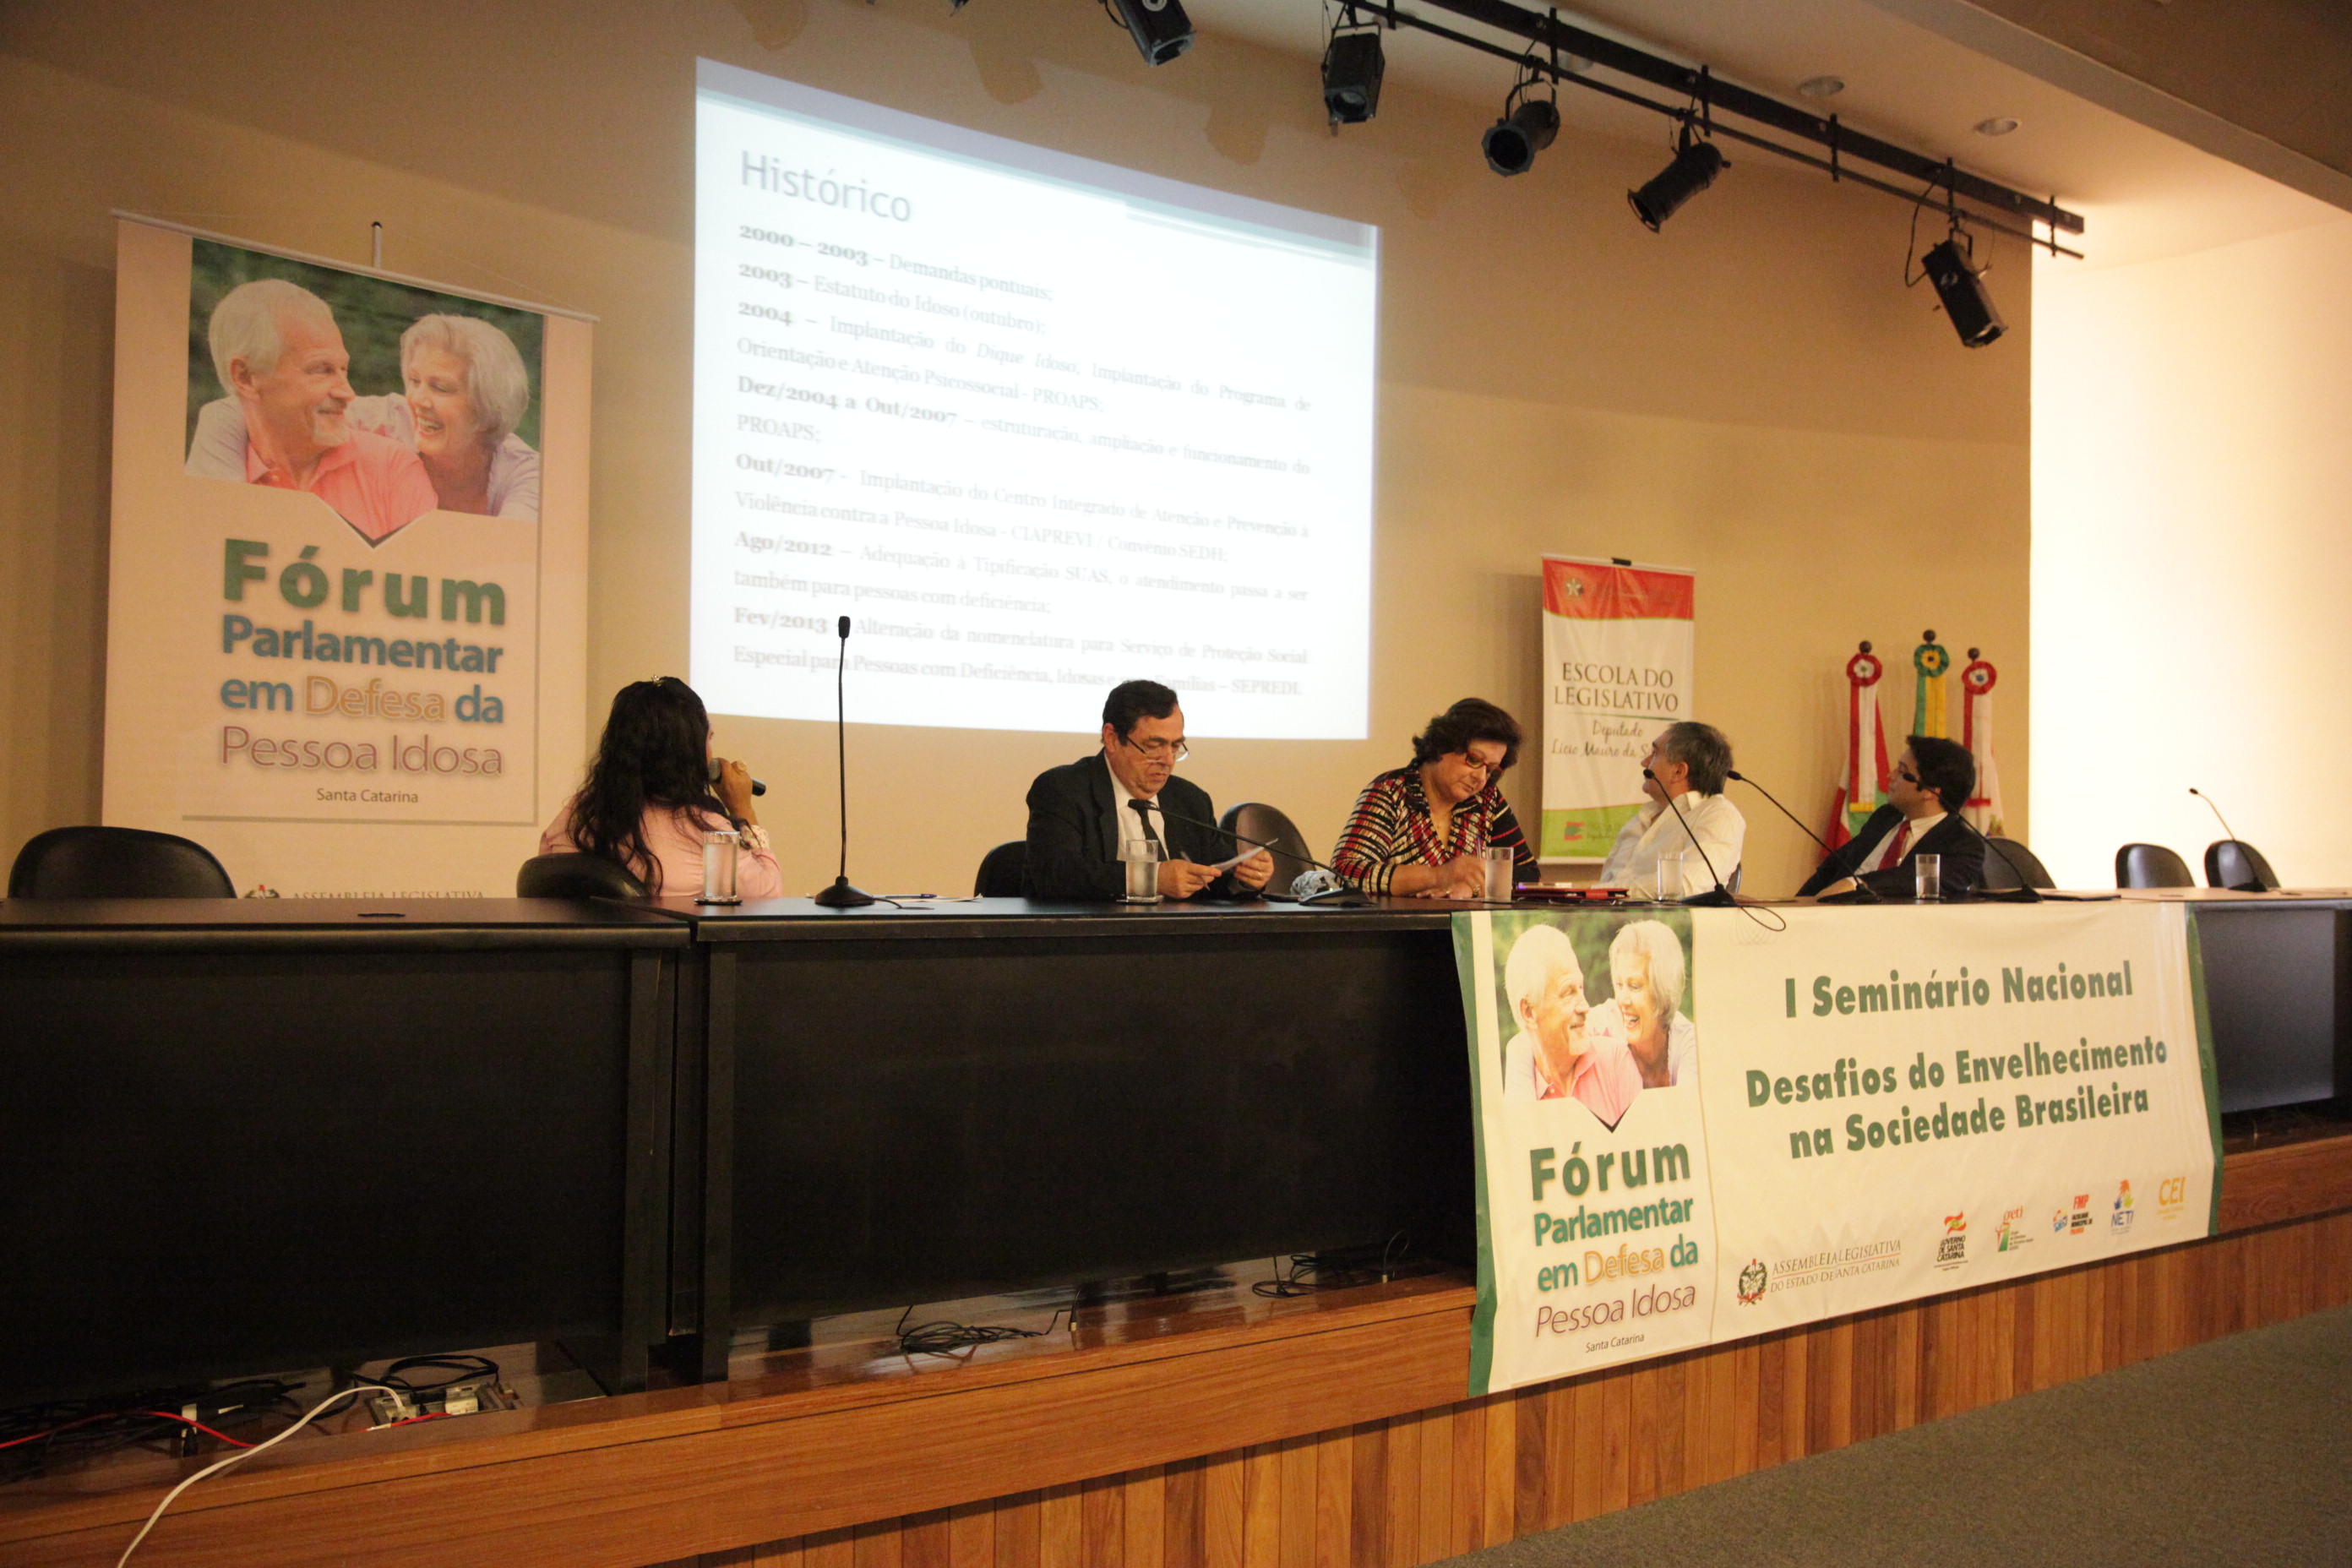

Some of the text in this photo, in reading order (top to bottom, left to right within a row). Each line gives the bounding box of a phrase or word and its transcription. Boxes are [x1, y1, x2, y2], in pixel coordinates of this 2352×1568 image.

[742, 150, 912, 222] Histórico
[739, 224, 795, 248] 2000
[817, 241, 869, 266] 2003
[890, 253, 977, 286] Demandas
[738, 263, 793, 288] 2003
[814, 274, 886, 303] Estatuto
[886, 288, 911, 308] do
[914, 294, 961, 318] Idoso
[737, 336, 836, 369] Orientação
[837, 358, 849, 371] e
[851, 357, 921, 384] Atenção
[923, 368, 1020, 399] Psicossocial
[738, 302, 793, 327] 2004
[830, 315, 935, 350] Implantação
[944, 335, 966, 354] do
[1092, 362, 1182, 392] Implantação
[1190, 378, 1209, 395] do
[1219, 384, 1287, 408] Programa
[1293, 395, 1311, 411] de
[738, 375, 839, 410] Dez/2004
[844, 397, 857, 409] a
[864, 396, 957, 423] Out/2007
[1088, 433, 1165, 455] ampliação
[1167, 445, 1178, 456] e
[1183, 444, 1288, 471] funcionamento
[1291, 458, 1311, 475] do
[735, 453, 836, 482] Out/2007
[860, 469, 963, 499] Implantação
[966, 482, 988, 500] do
[993, 487, 1048, 507] Centro
[1052, 493, 1125, 517] Integrado
[1129, 503, 1147, 519] de
[1152, 508, 1210, 528] Atenção
[1211, 517, 1222, 528] e
[1227, 515, 1297, 538] Prevenção
[1298, 523, 1309, 537] à
[733, 490, 818, 517] Violência
[818, 506, 877, 523] contra
[878, 513, 890, 525] a
[894, 510, 950, 532] Pessoa
[953, 518, 997, 536] Idosa
[1010, 525, 1092, 547] CIAPREVI
[1107, 536, 1177, 556] Convênio
[223, 538, 506, 626] Fórum
[733, 531, 832, 556] Ago/2012
[859, 544, 951, 569] Adequação
[956, 554, 966, 569] à
[973, 556, 1059, 580] Tipificação
[1119, 574, 1129, 585] o
[1135, 574, 1224, 594] atendimento
[1229, 585, 1269, 599] passa
[1273, 589, 1282, 599] a
[1288, 590, 1309, 601] ser
[733, 569, 808, 592] também
[810, 580, 852, 597] para
[852, 585, 918, 602] pessoas
[920, 591, 956, 605] com
[221, 615, 504, 673] Parlamentar
[734, 607, 1308, 664] Fev/2013 Alteração da nomenclatura para Serviço de Proteção Social
[732, 645, 808, 668] Especial
[852, 654, 918, 674] Pessoas
[919, 663, 956, 677] com
[1056, 667, 1102, 685] Idosas
[1562, 662, 1674, 689] ESCOLA DO
[220, 676, 504, 724] em Defesa da
[1554, 686, 1679, 712] LEGISLATIVO
[221, 725, 503, 775] Pessoa Idosa
[1582, 742, 1620, 756] Mauro
[1592, 720, 1643, 743] Deputado
[317, 788, 418, 803] Santa Catarina
[1785, 960, 2133, 1018] I Seminário Nacional
[1745, 1035, 2167, 1108] Desafios do Envelhecimento
[1789, 1081, 2149, 1159] na Sociedade Brasileira
[1530, 1141, 1690, 1201] Fórum
[2159, 1176, 2186, 1206] CEI
[1534, 1198, 1694, 1247] Parlamentar
[1940, 1235, 1966, 1246] GOVERNO
[2111, 1210, 2134, 1227] NETI
[1538, 1233, 1699, 1293] em Defesa da
[1772, 1239, 1901, 1276] ASSEMBLEIA LEGISLATIVA
[1936, 1251, 1965, 1262] CATARINA
[1946, 1242, 1965, 1252] SANTA
[1770, 1257, 1900, 1293] DO ESTADO DE SANTA CATARINA
[1536, 1284, 1696, 1338] Pessoa Idosa
[1585, 1333, 1645, 1353] Santa Catarina
